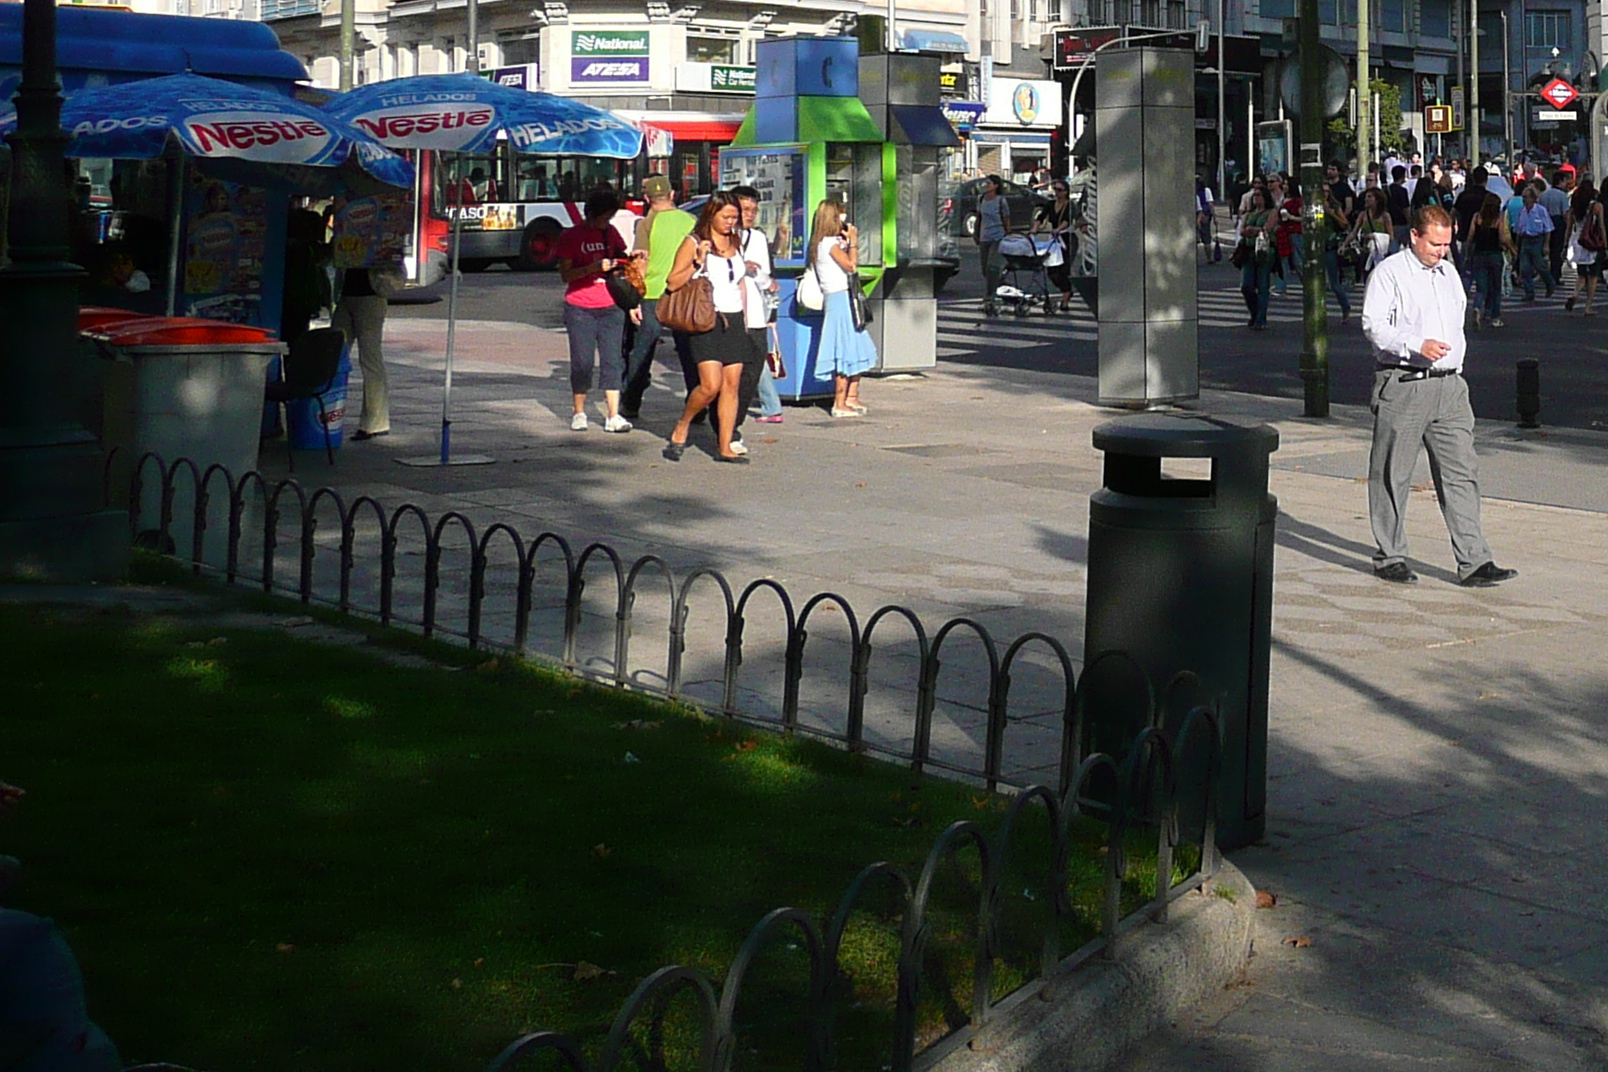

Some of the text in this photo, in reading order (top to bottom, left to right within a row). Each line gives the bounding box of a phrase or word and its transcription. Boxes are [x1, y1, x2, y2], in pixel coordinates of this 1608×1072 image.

[580, 62, 641, 77] ATESA
[381, 92, 477, 108] HELADOS
[72, 115, 168, 138] ADOS
[511, 118, 620, 148] HELADOS
